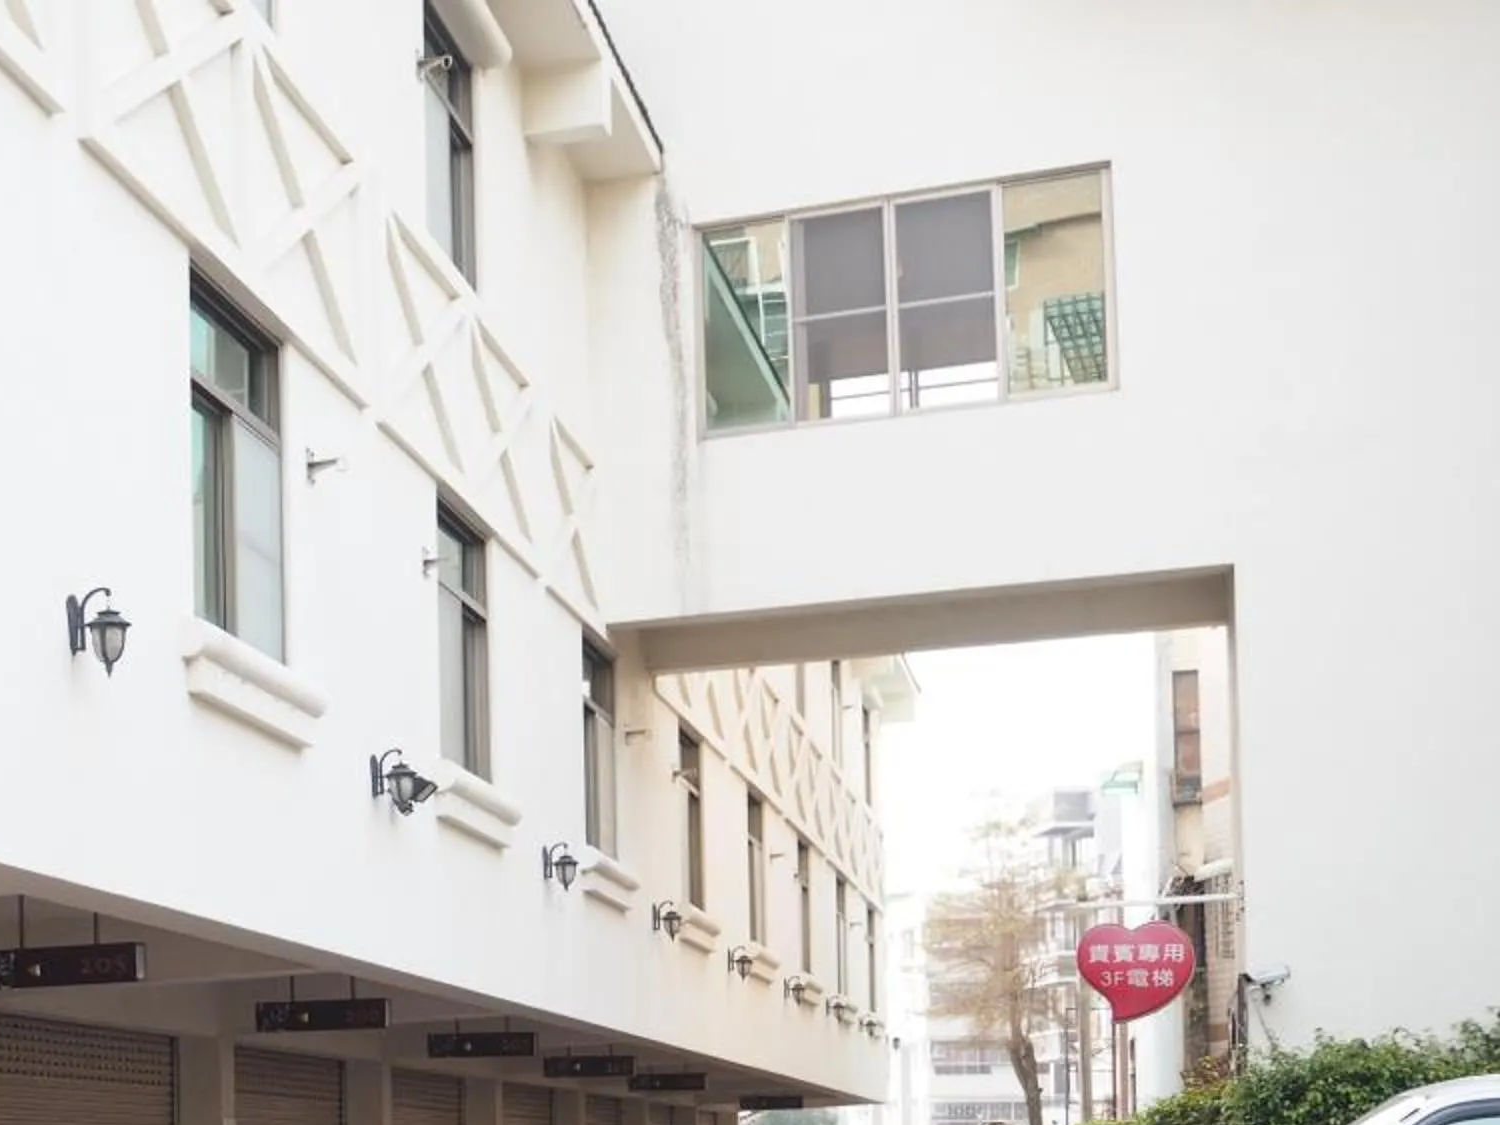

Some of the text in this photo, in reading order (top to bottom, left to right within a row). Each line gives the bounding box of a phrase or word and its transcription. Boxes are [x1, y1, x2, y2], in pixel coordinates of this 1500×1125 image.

[1088, 943, 1185, 963] 貴賓專用
[1100, 968, 1174, 987] 3F電梯
